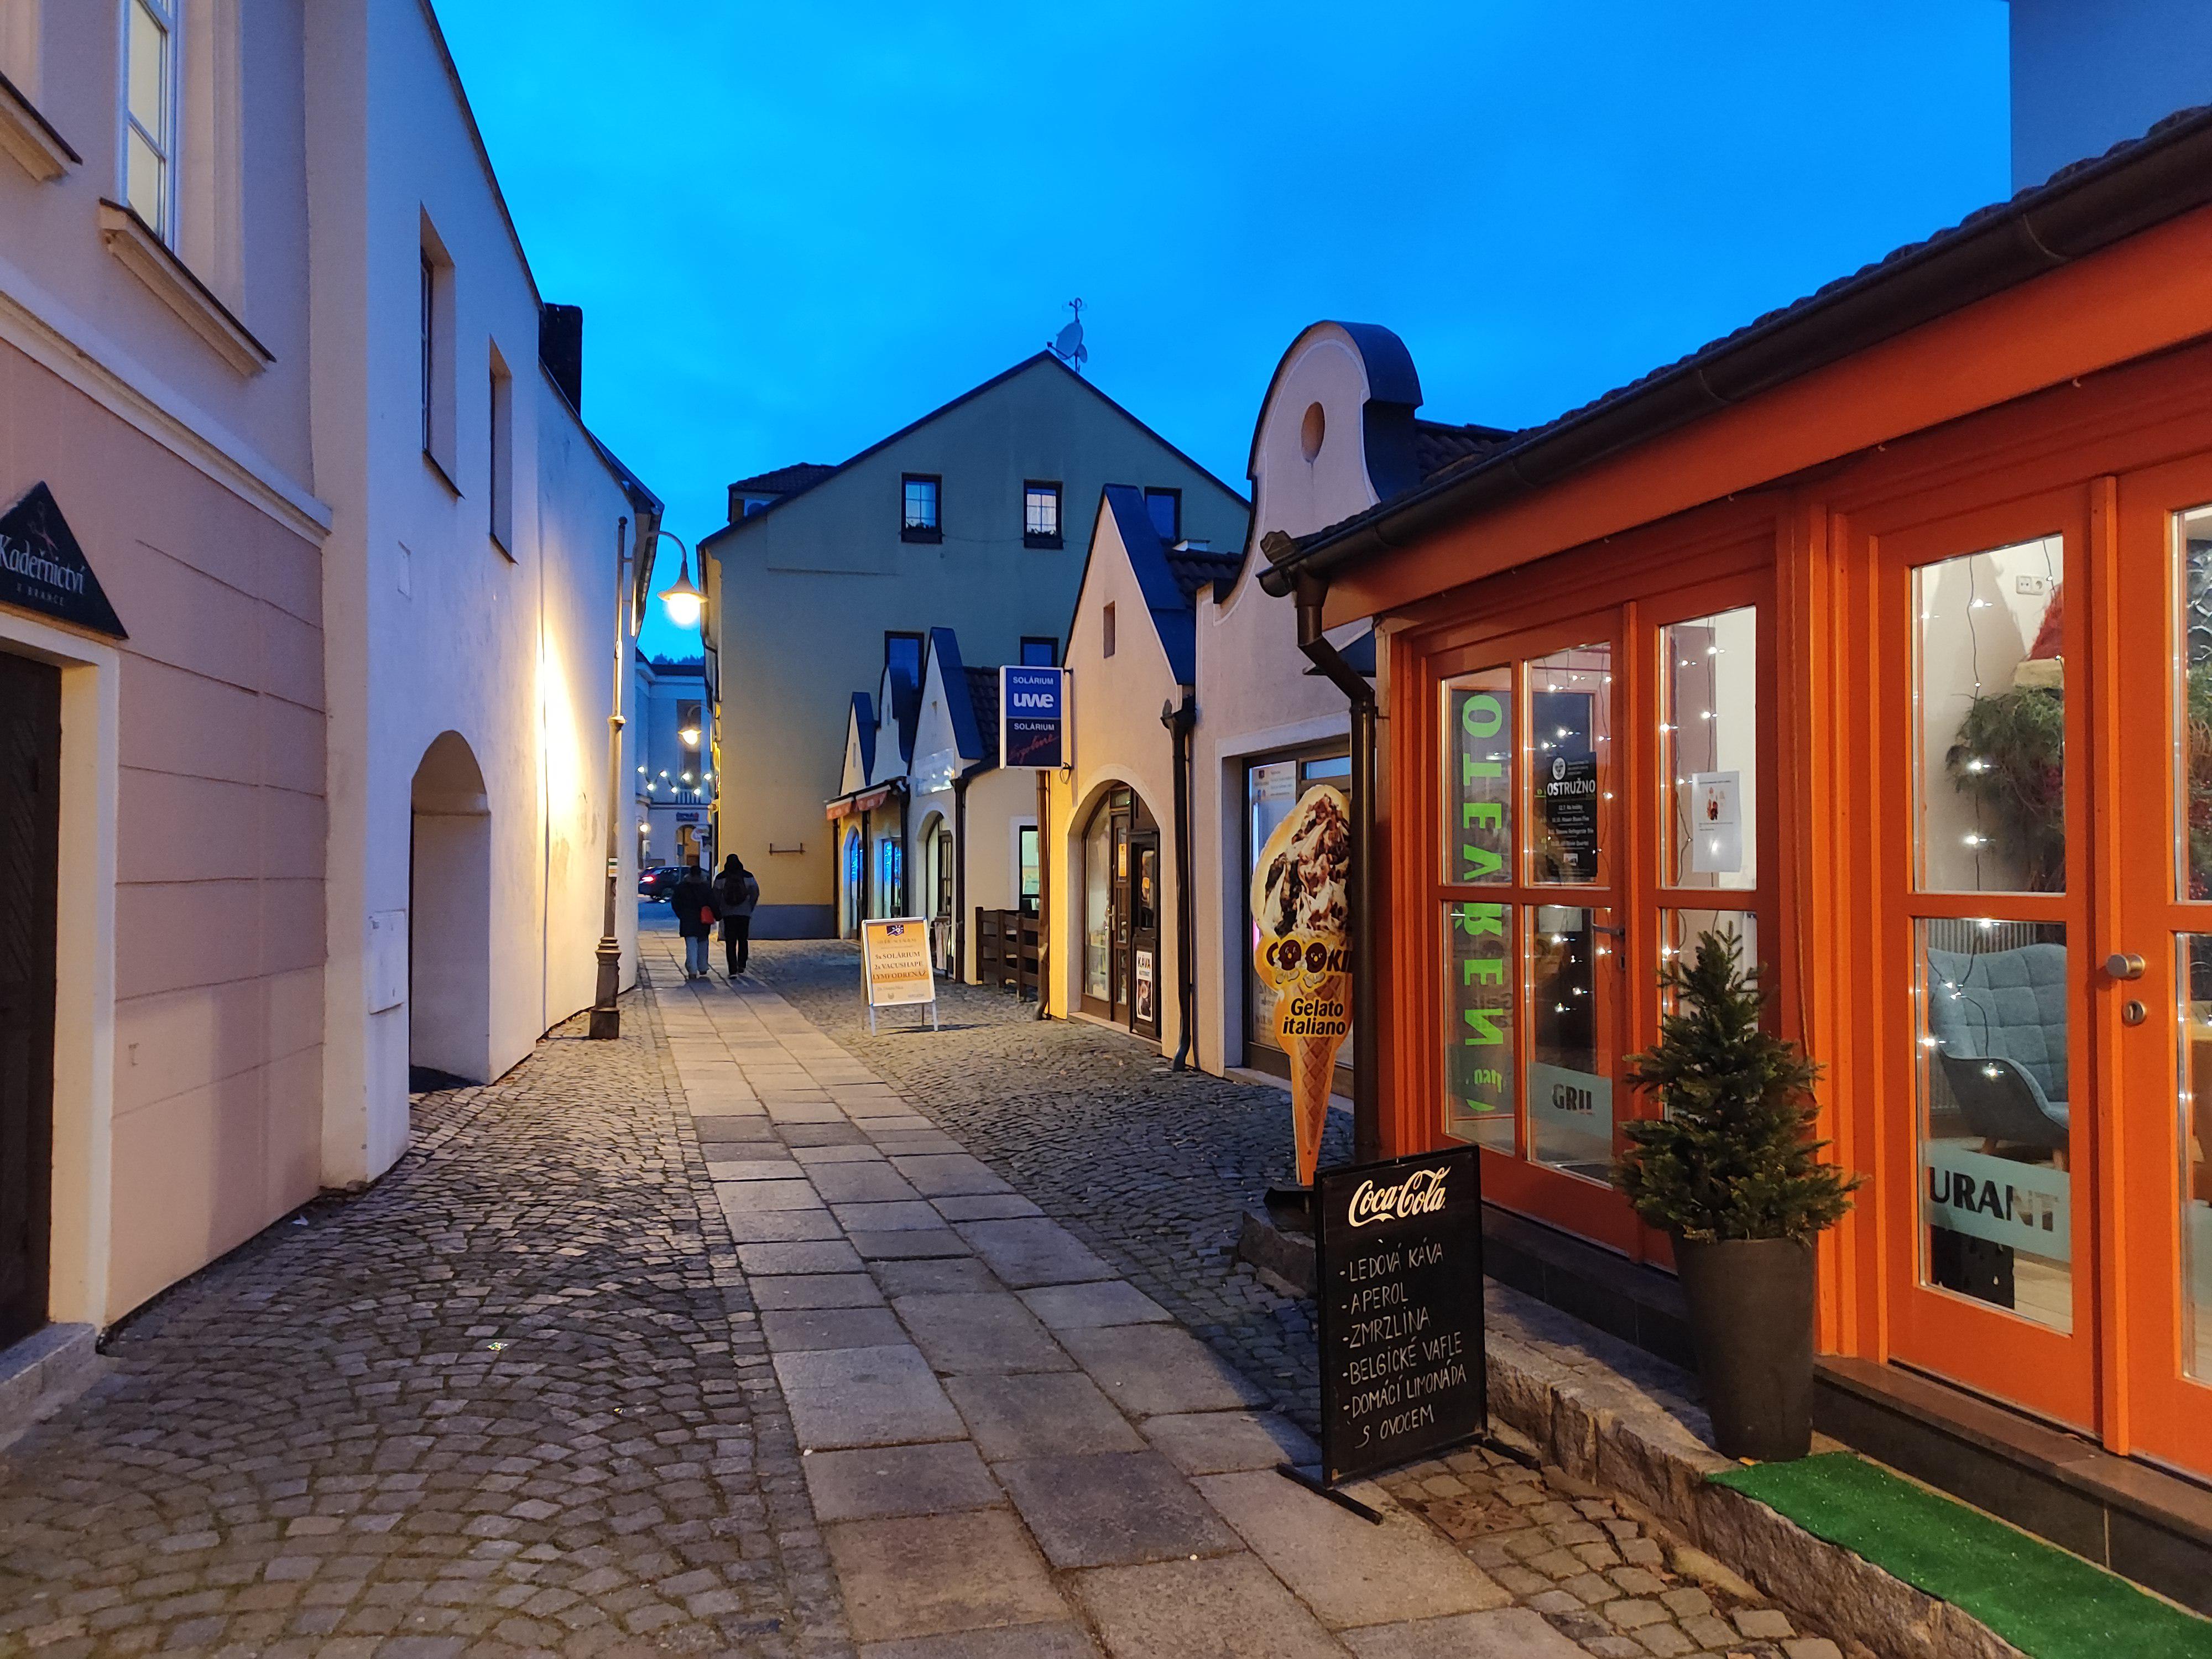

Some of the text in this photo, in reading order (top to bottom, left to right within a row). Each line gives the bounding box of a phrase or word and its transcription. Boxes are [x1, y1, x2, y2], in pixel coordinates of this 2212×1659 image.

[1013, 676, 1053, 685] SOLÁRIUM
[1013, 693, 1054, 708] uwe
[1014, 722, 1055, 731] SOLÁRIUM
[1547, 778, 1596, 796] OSTRUŽNO
[1138, 955, 1151, 969] KÁVA
[1291, 998, 1344, 1017] Gelato
[1282, 1016, 1346, 1035] italiano
[1348, 1165, 1452, 1227] Coca-Cola
[1408, 1237, 1444, 1269] KÁVA
[1422, 1332, 1463, 1361] VAFLE
[1406, 1359, 1467, 1399] LIMONÁDA
[1380, 1404, 1435, 1440] OVOCEM
